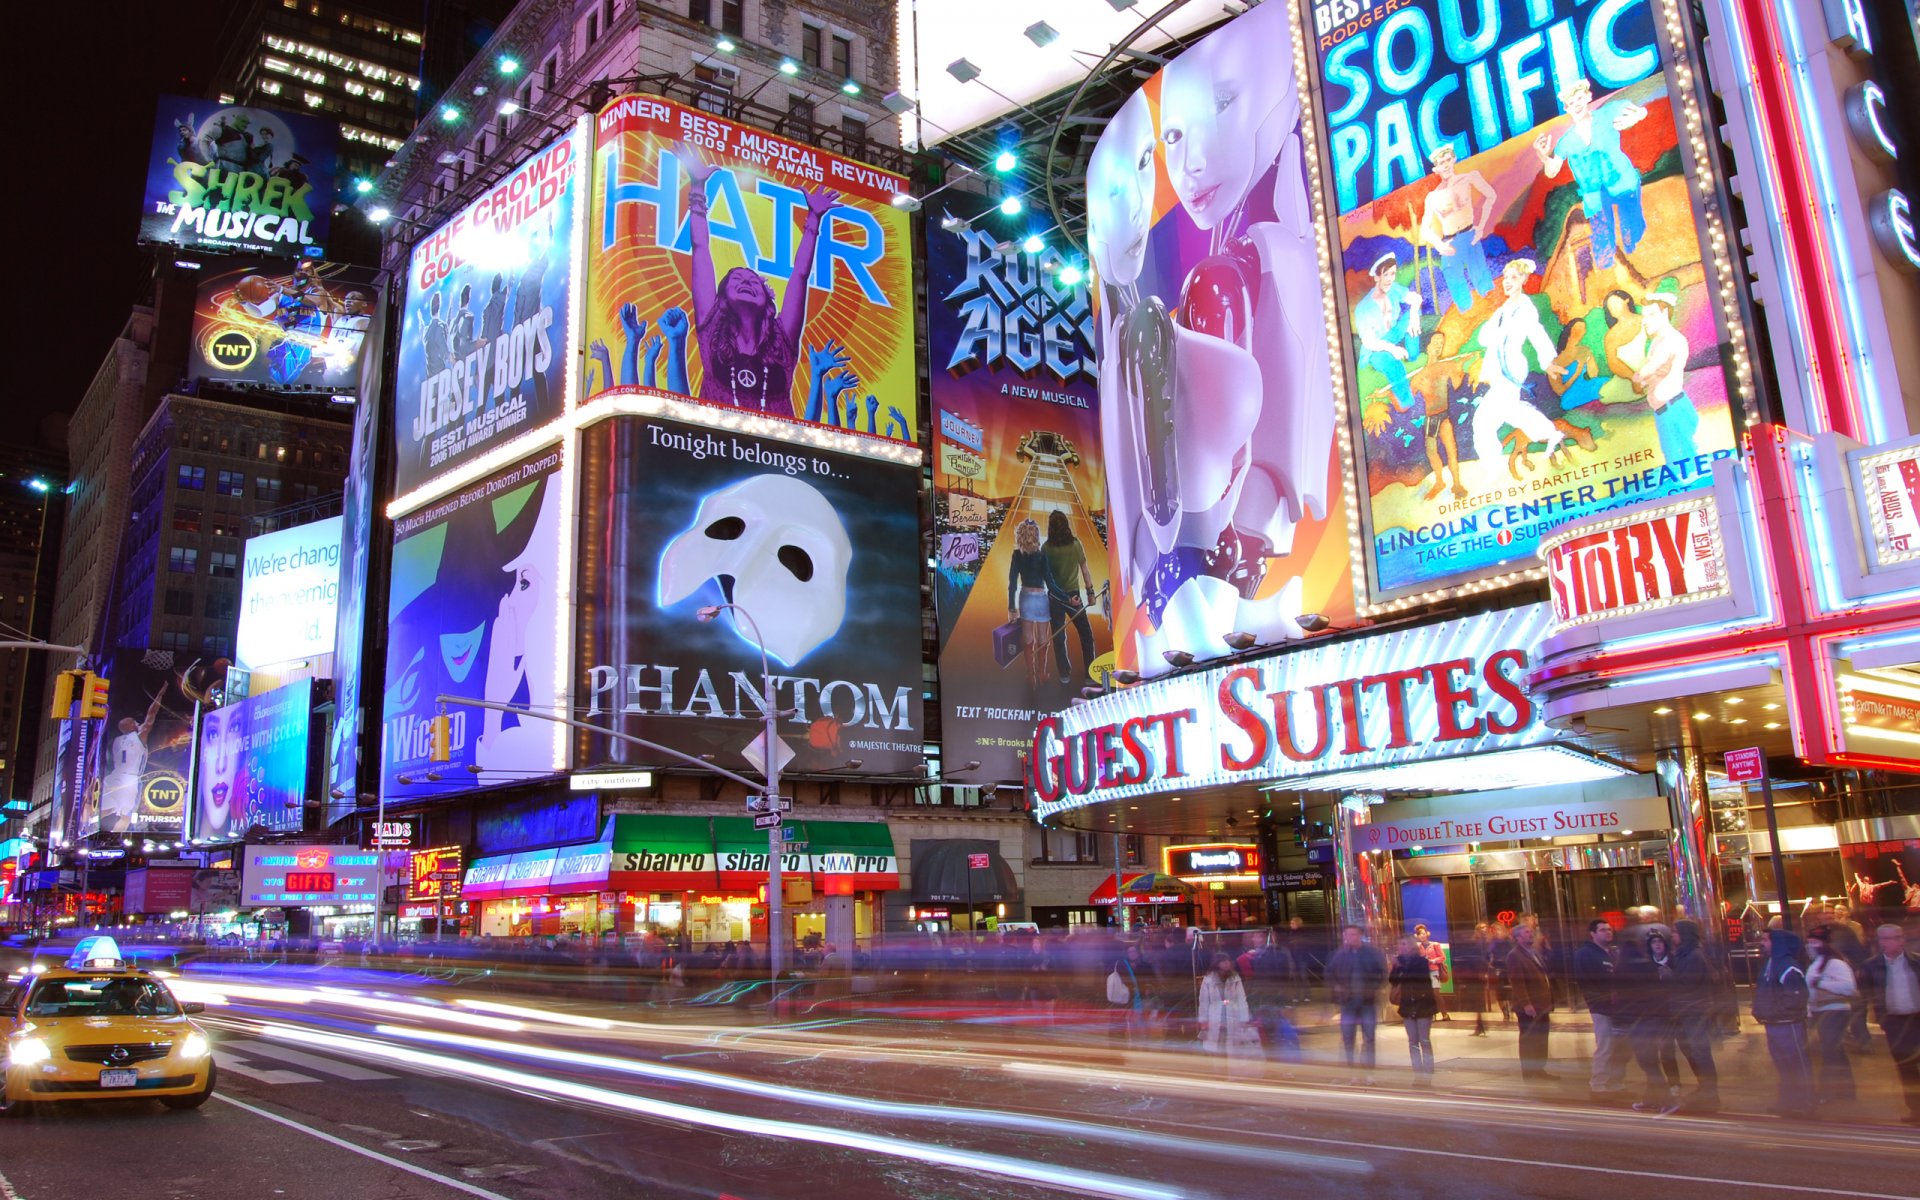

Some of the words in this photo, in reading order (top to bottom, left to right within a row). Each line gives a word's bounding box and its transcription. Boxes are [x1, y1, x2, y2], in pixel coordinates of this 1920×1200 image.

[1314, 0, 1371, 36] BEST
[1331, 0, 1659, 214] PACIFIC
[600, 100, 670, 134] WINNER!
[680, 112, 732, 143] BEST
[740, 131, 824, 172] MUSICAL
[831, 162, 904, 195] REVIVAL
[683, 130, 726, 152] 2009
[732, 146, 770, 167] TONY
[777, 160, 825, 183] AWARD
[167, 157, 315, 222] SHREK
[472, 138, 573, 221] CROWD
[156, 200, 177, 215] THE
[170, 202, 314, 245] MUSICAL
[602, 148, 893, 309] HAIR
[203, 238, 242, 248] BROADWAY
[243, 243, 272, 252] THEATRE
[1025, 292, 1053, 318] OF
[215, 344, 250, 357] TNT
[946, 292, 1098, 387] AGES
[412, 341, 492, 443] JERSEY
[493, 306, 553, 398] BOYS
[1000, 383, 1008, 394] A
[1011, 385, 1038, 400] NEW
[1041, 389, 1089, 409] MUSICAL
[431, 425, 464, 454] BEST
[466, 393, 527, 436] MUSICAL
[943, 419, 980, 445] JOURNEY
[430, 450, 448, 468] 2006
[448, 439, 466, 458] TONY
[466, 423, 494, 449] AWARD
[496, 406, 527, 433] WINNER
[648, 425, 726, 460] Tonight
[732, 443, 806, 476] belongs
[1438, 490, 1504, 515] DIRECTED
[1507, 483, 1528, 498] BY
[1532, 460, 1611, 491] BARTLETT
[1614, 448, 1655, 468] SHER
[960, 498, 975, 512] Pat
[1378, 512, 1479, 556] LINCOLN
[1486, 484, 1597, 526] CENTER
[1602, 448, 1737, 496] THEATER
[289, 543, 339, 570] chang
[1415, 542, 1457, 564] TAKE
[1461, 533, 1494, 551] THE
[1550, 511, 1691, 622] STORY
[587, 664, 914, 731] PHANTOM
[956, 706, 981, 718] TEXT
[251, 728, 273, 748] WITH
[856, 740, 889, 751] MAJESTIC
[891, 743, 922, 753] THEATRE
[997, 737, 1025, 747] Brooks
[1732, 760, 1755, 769] ANYTIME
[1735, 750, 1757, 760] STANDING
[582, 776, 599, 786] city
[604, 775, 641, 784] outdoor
[151, 790, 178, 800] TNT
[1488, 815, 1548, 836] GUEST
[1553, 810, 1619, 831] SUITES
[559, 851, 602, 874] sbarro
[624, 849, 705, 871] sbarro
[287, 874, 332, 891] GIFTS
[1284, 873, 1304, 881] Subway
[626, 896, 648, 905] Pizza
[701, 896, 722, 904] Pasta
